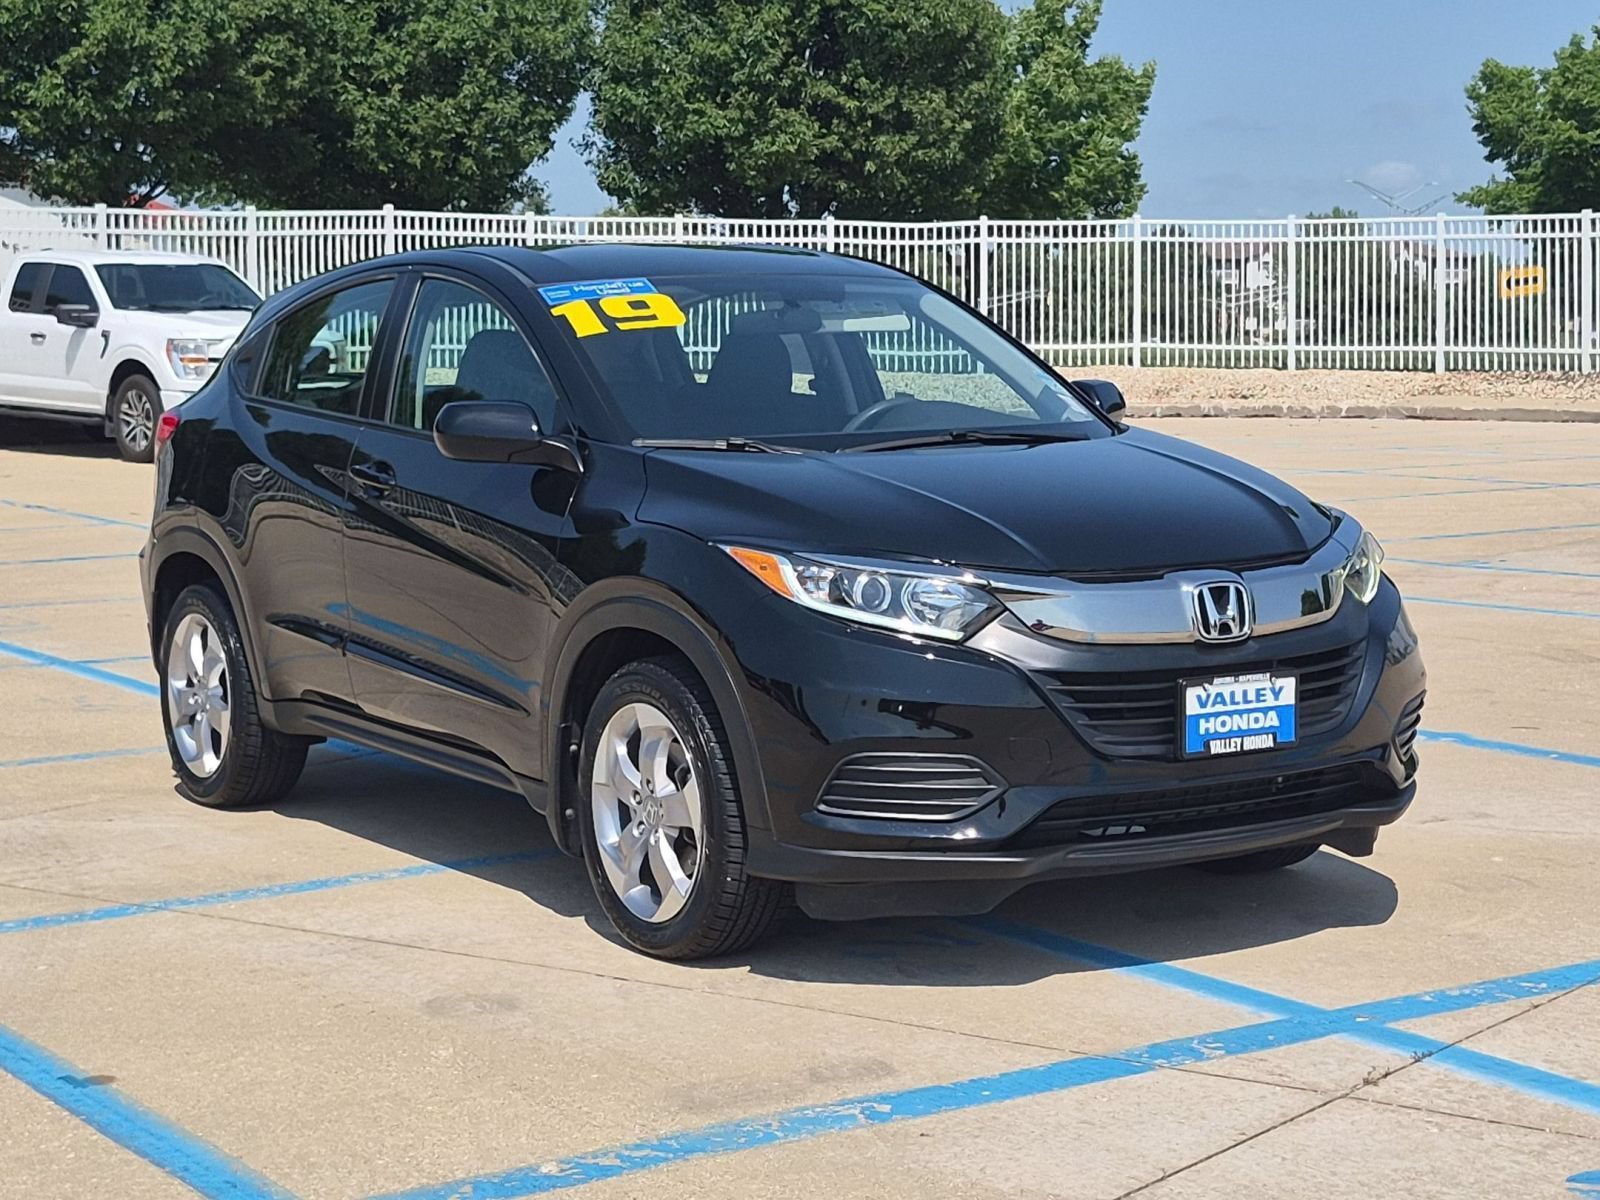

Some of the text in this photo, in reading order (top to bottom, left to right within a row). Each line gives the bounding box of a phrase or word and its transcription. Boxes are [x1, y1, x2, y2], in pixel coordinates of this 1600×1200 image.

[550, 293, 686, 338] 19
[1196, 686, 1285, 709] VALLEY
[1199, 710, 1280, 735] HONDA
[1209, 734, 1274, 755] VALLEY HONDA
